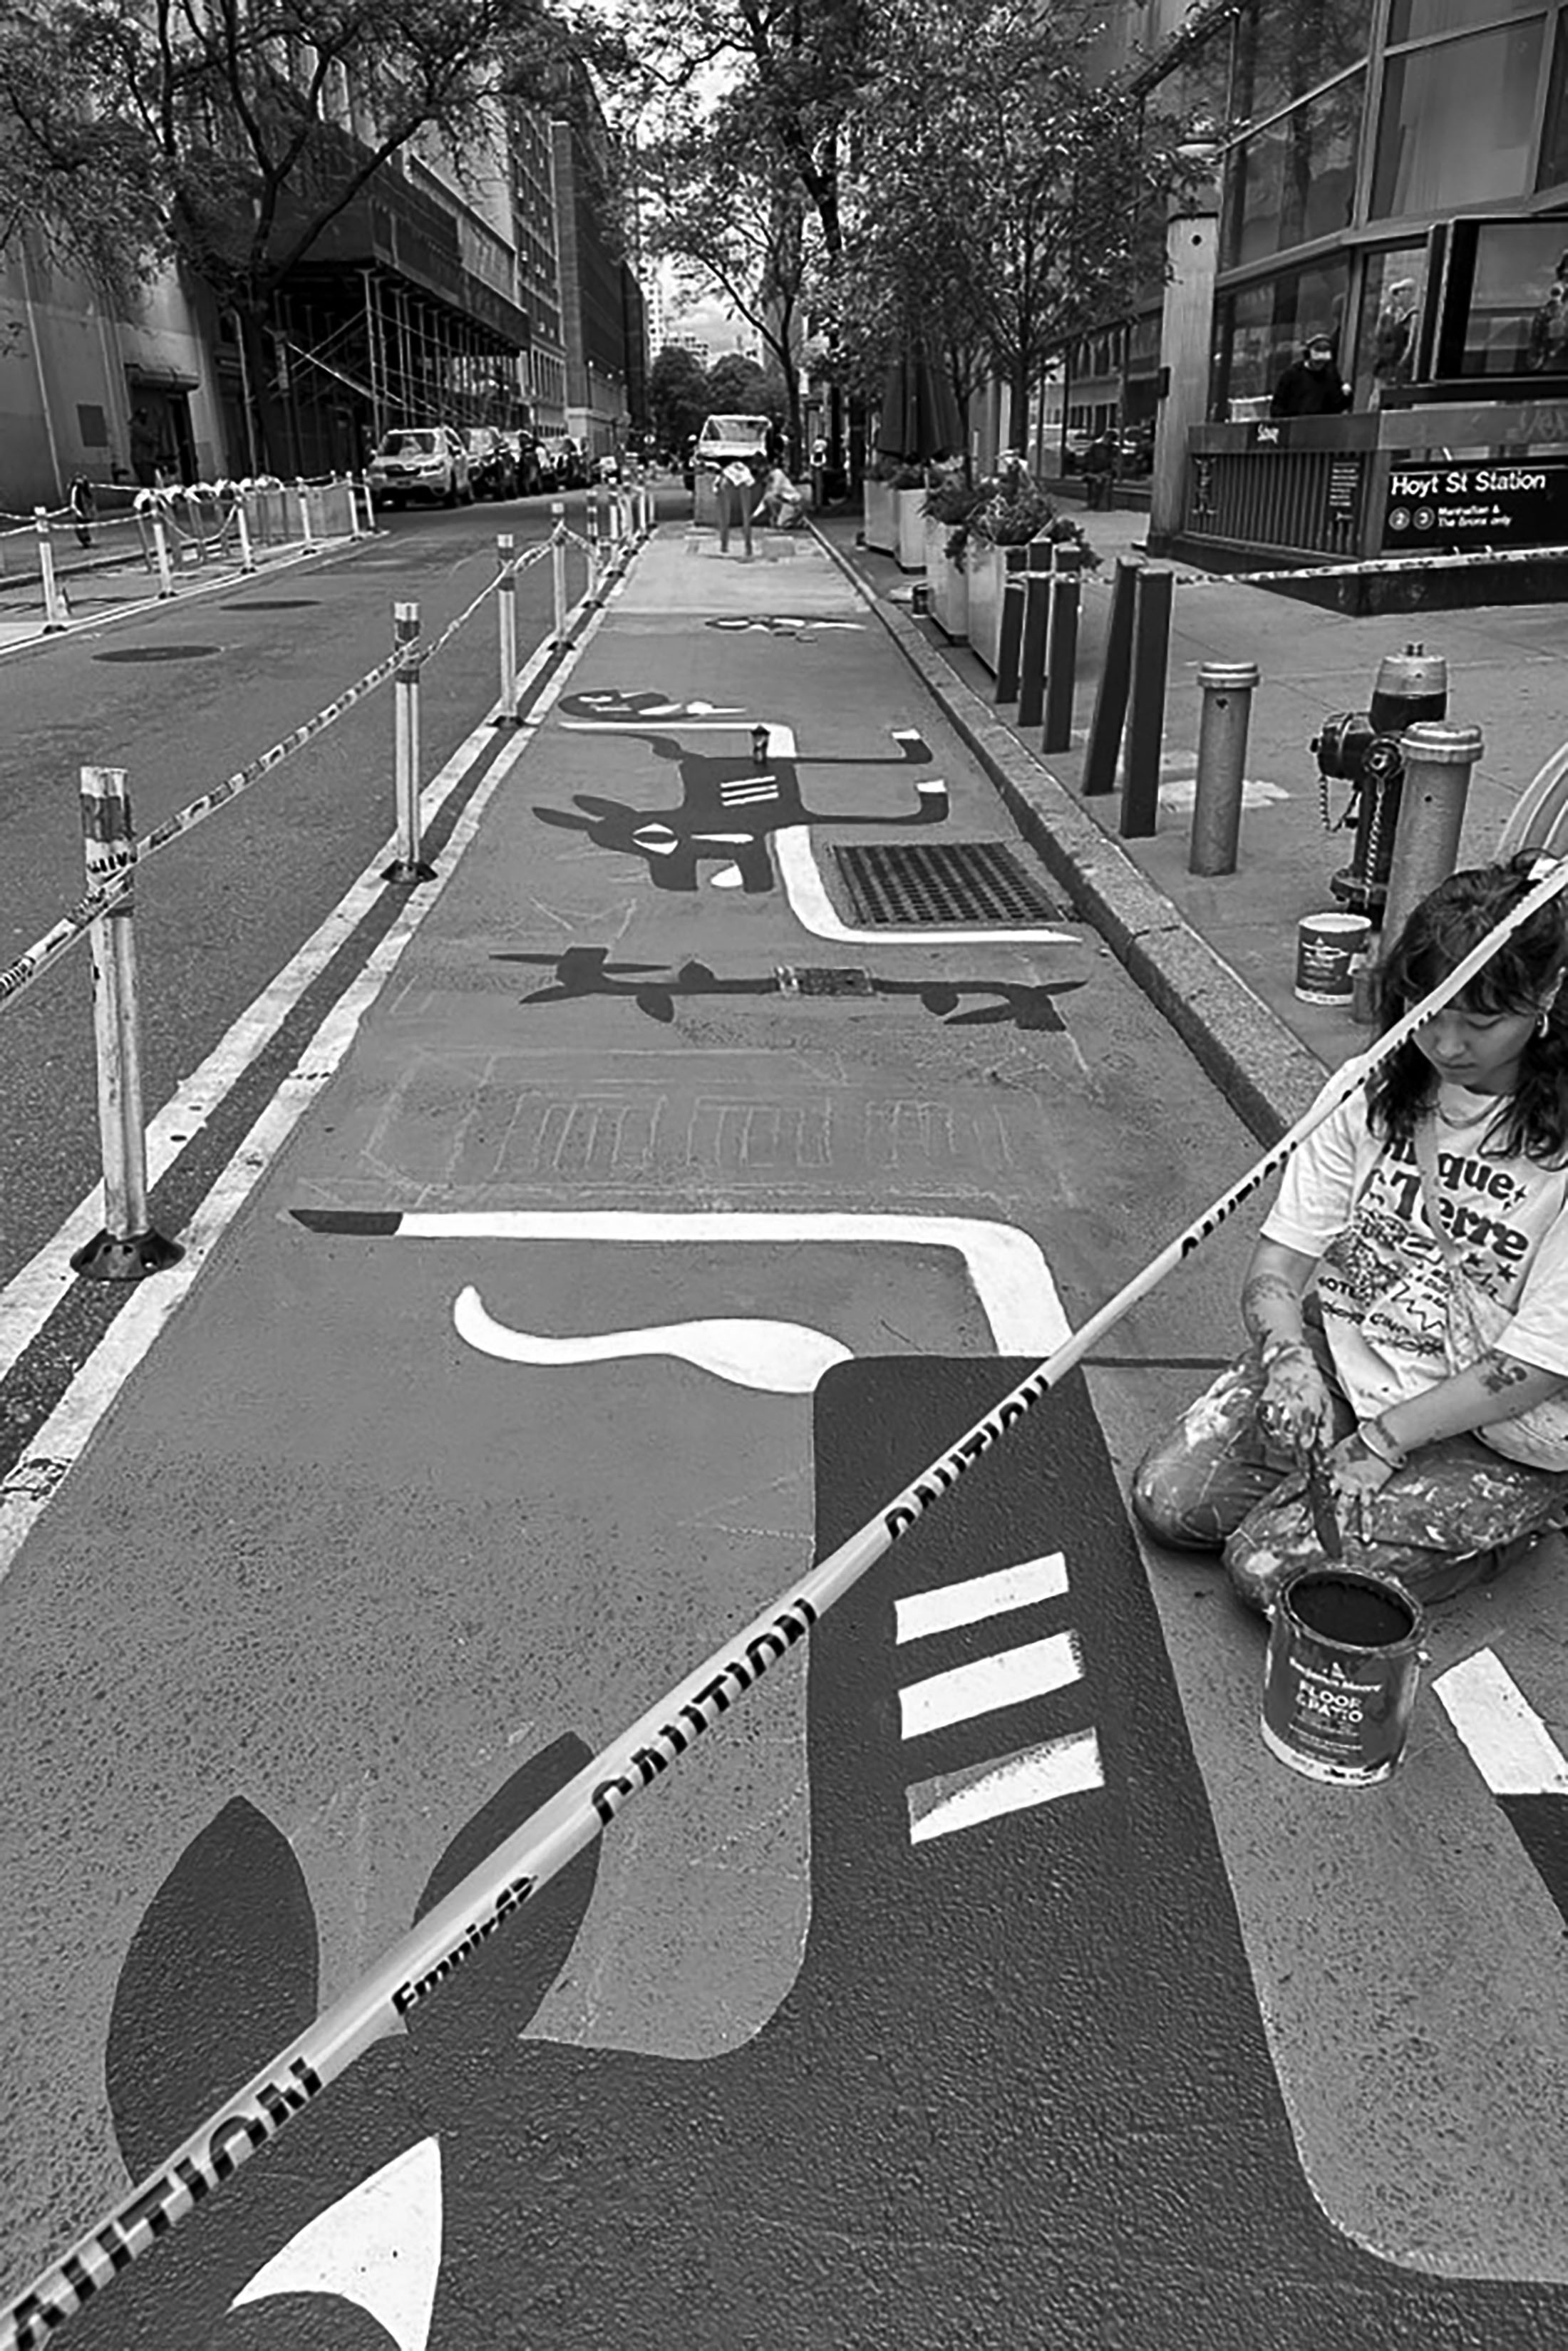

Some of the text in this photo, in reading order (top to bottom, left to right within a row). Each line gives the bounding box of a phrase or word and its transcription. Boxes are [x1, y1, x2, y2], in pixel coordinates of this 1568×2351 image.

[1391, 469, 1546, 498] Hoyt St Station
[13, 2057, 322, 2351] AUTION
